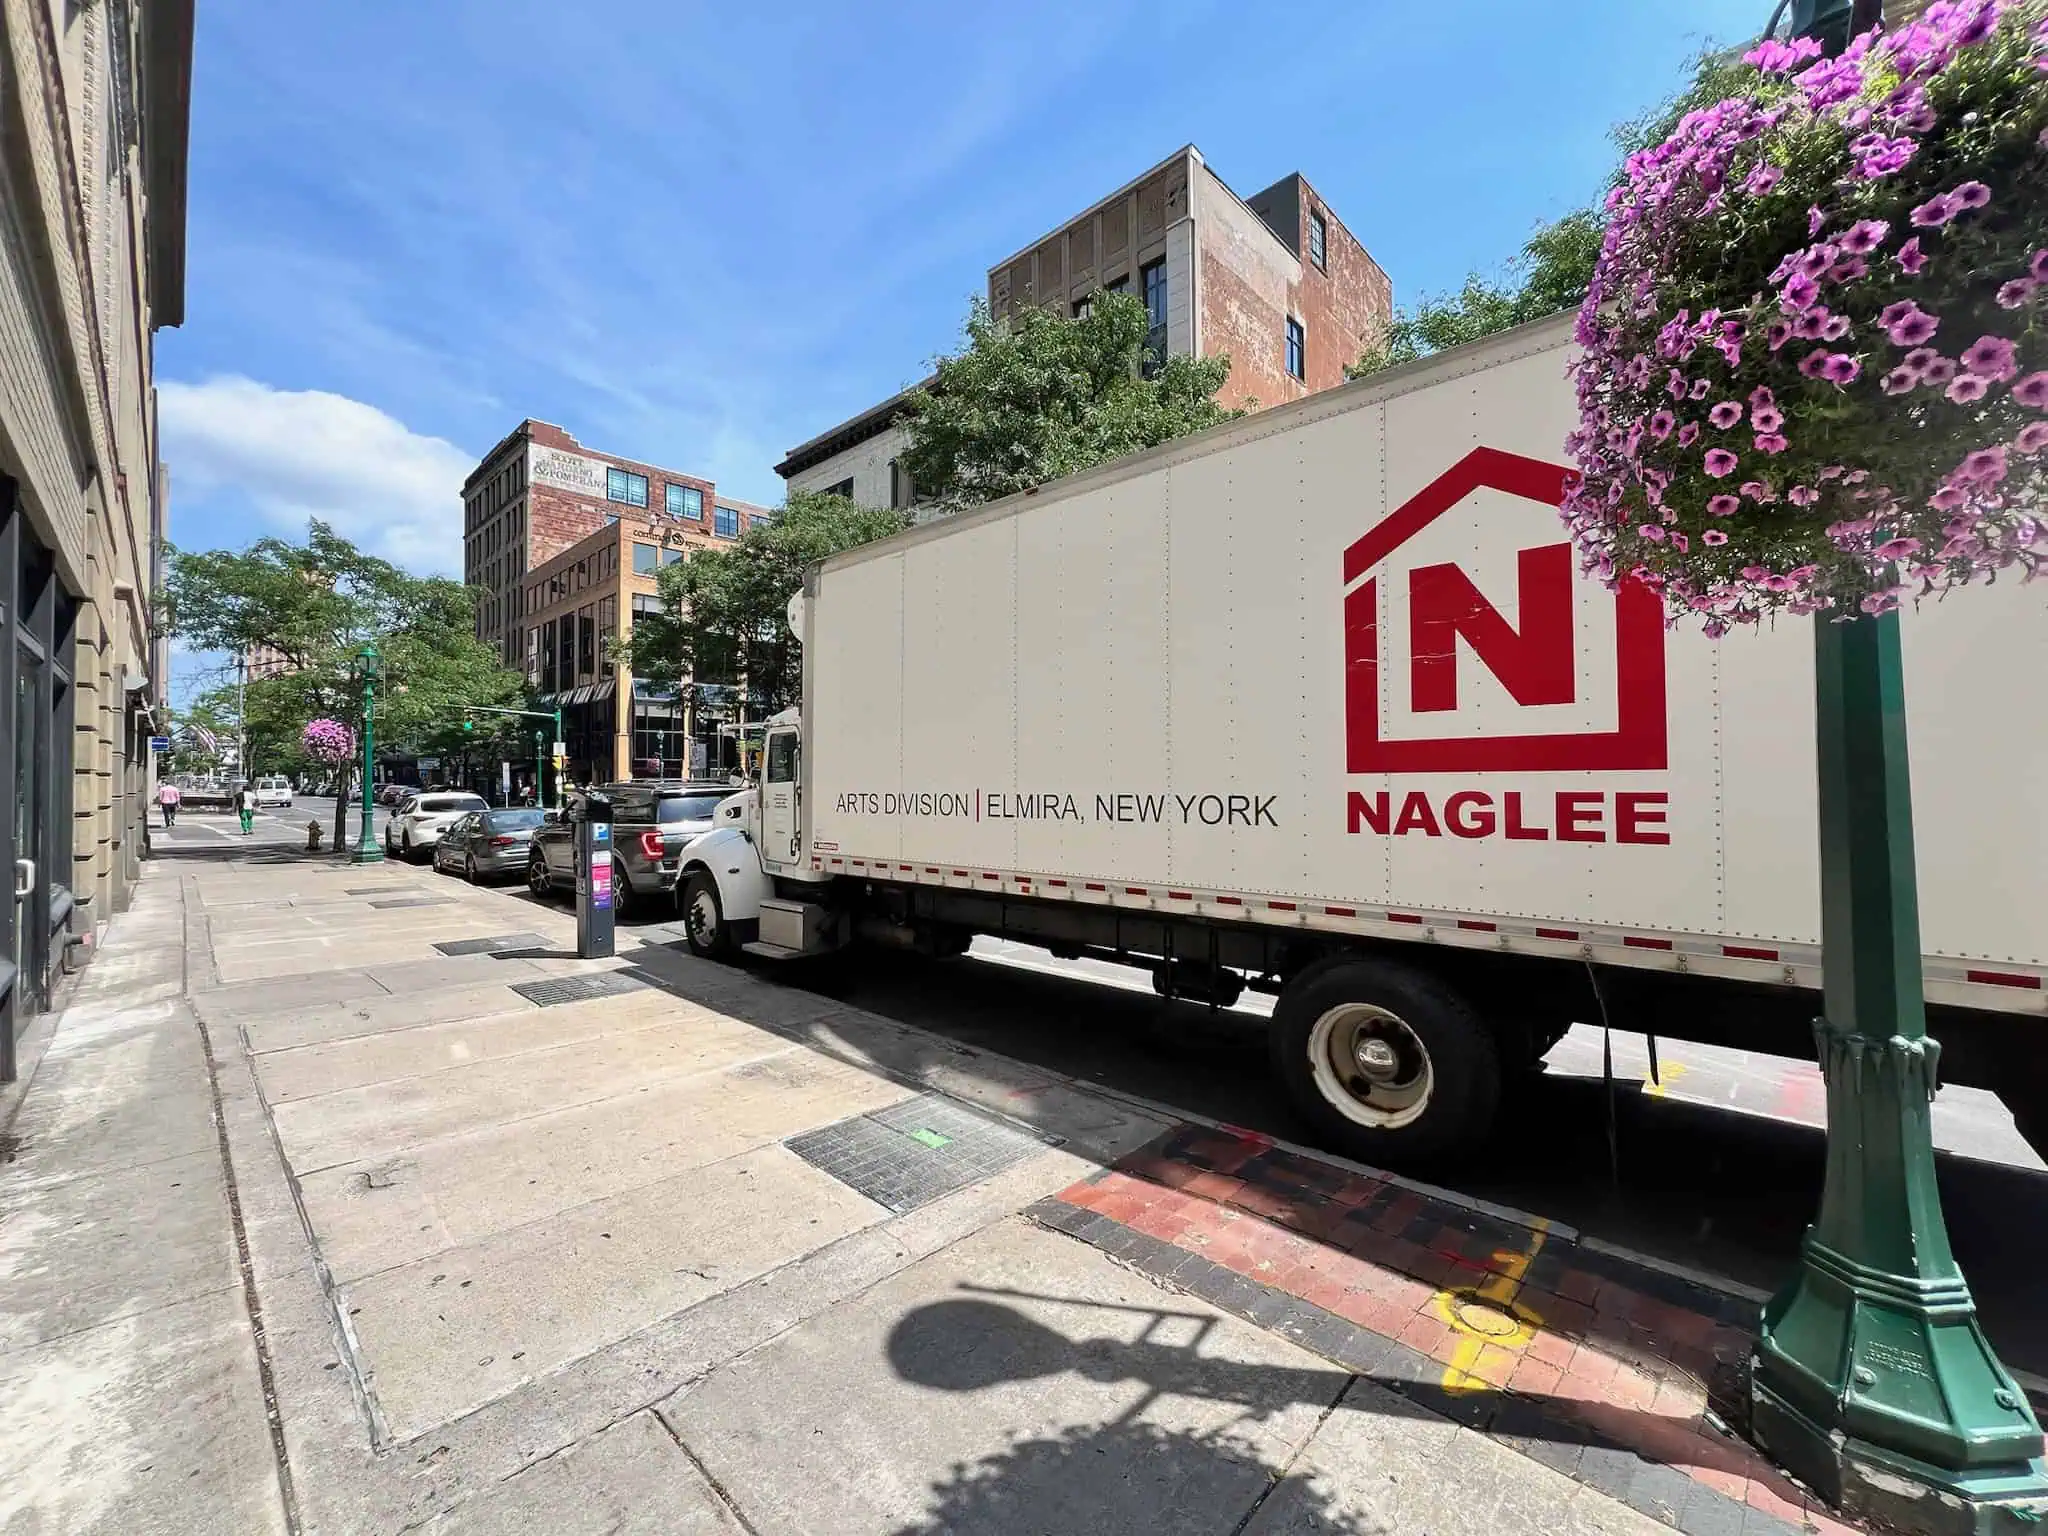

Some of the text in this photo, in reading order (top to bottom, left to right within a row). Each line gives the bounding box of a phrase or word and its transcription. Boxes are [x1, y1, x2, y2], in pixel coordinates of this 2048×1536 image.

[1409, 542, 1576, 713] N
[836, 793, 1278, 826] ARTS DIVISION ELMIRA, NEW YORK
[1346, 790, 1671, 846] NAGLEE
